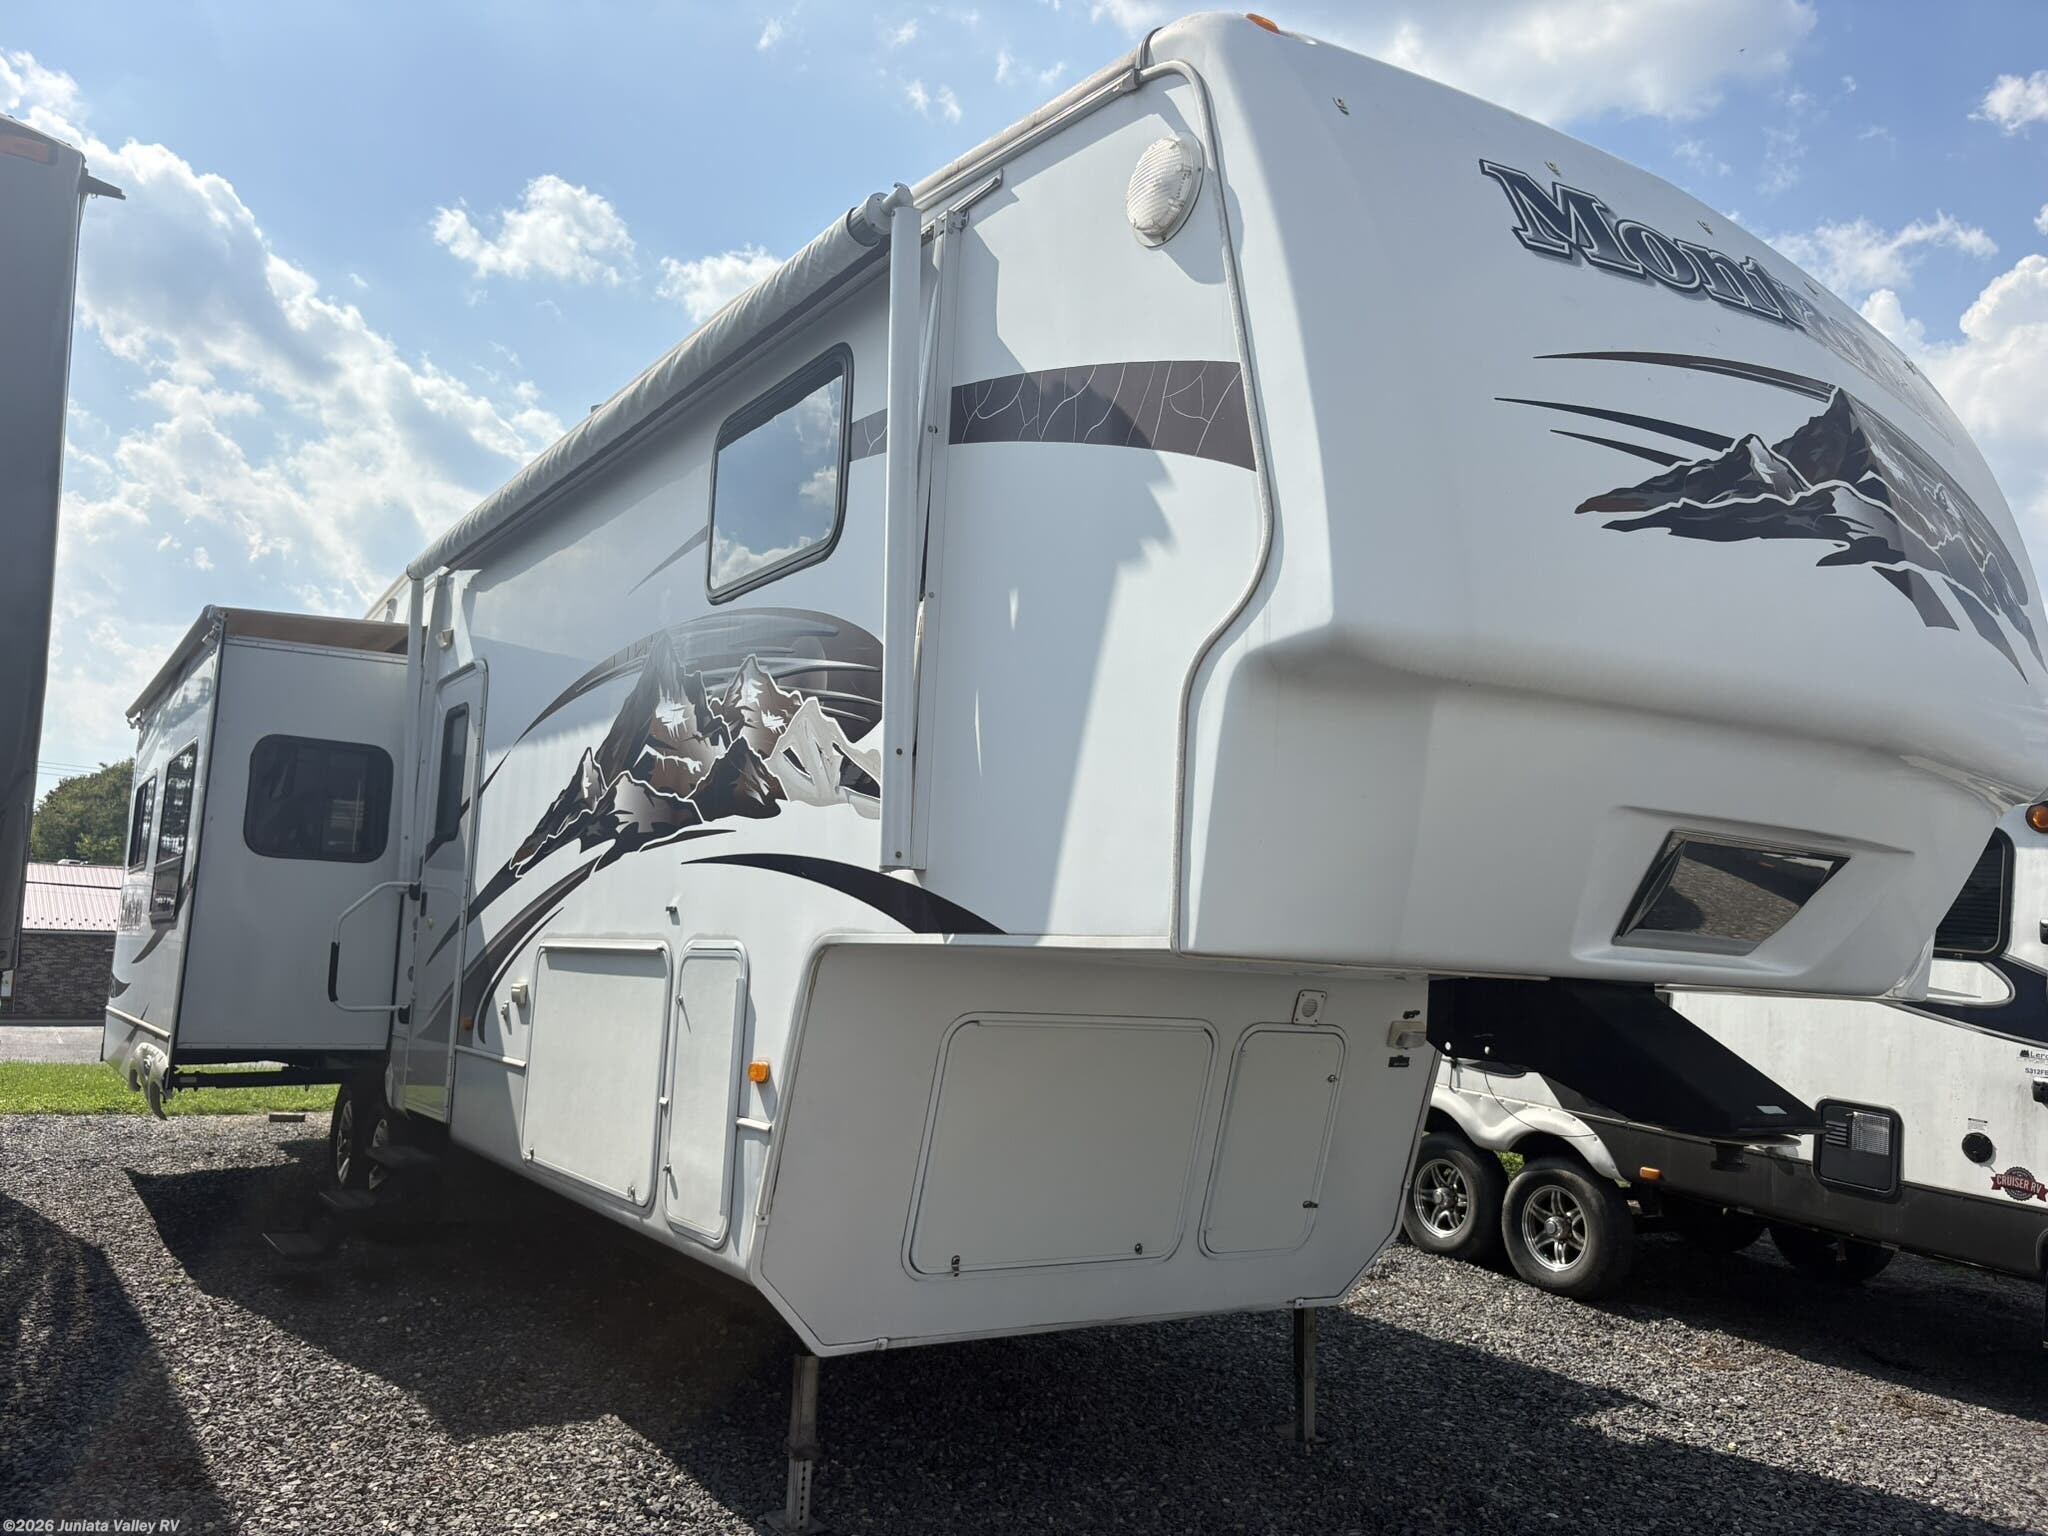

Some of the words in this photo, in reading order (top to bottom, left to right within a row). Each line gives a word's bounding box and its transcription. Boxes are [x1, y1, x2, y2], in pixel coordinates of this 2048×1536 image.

[1479, 158, 1950, 440] Mont
[1996, 1174, 2030, 1191] CRUISER
[2030, 1181, 2042, 1194] RV
